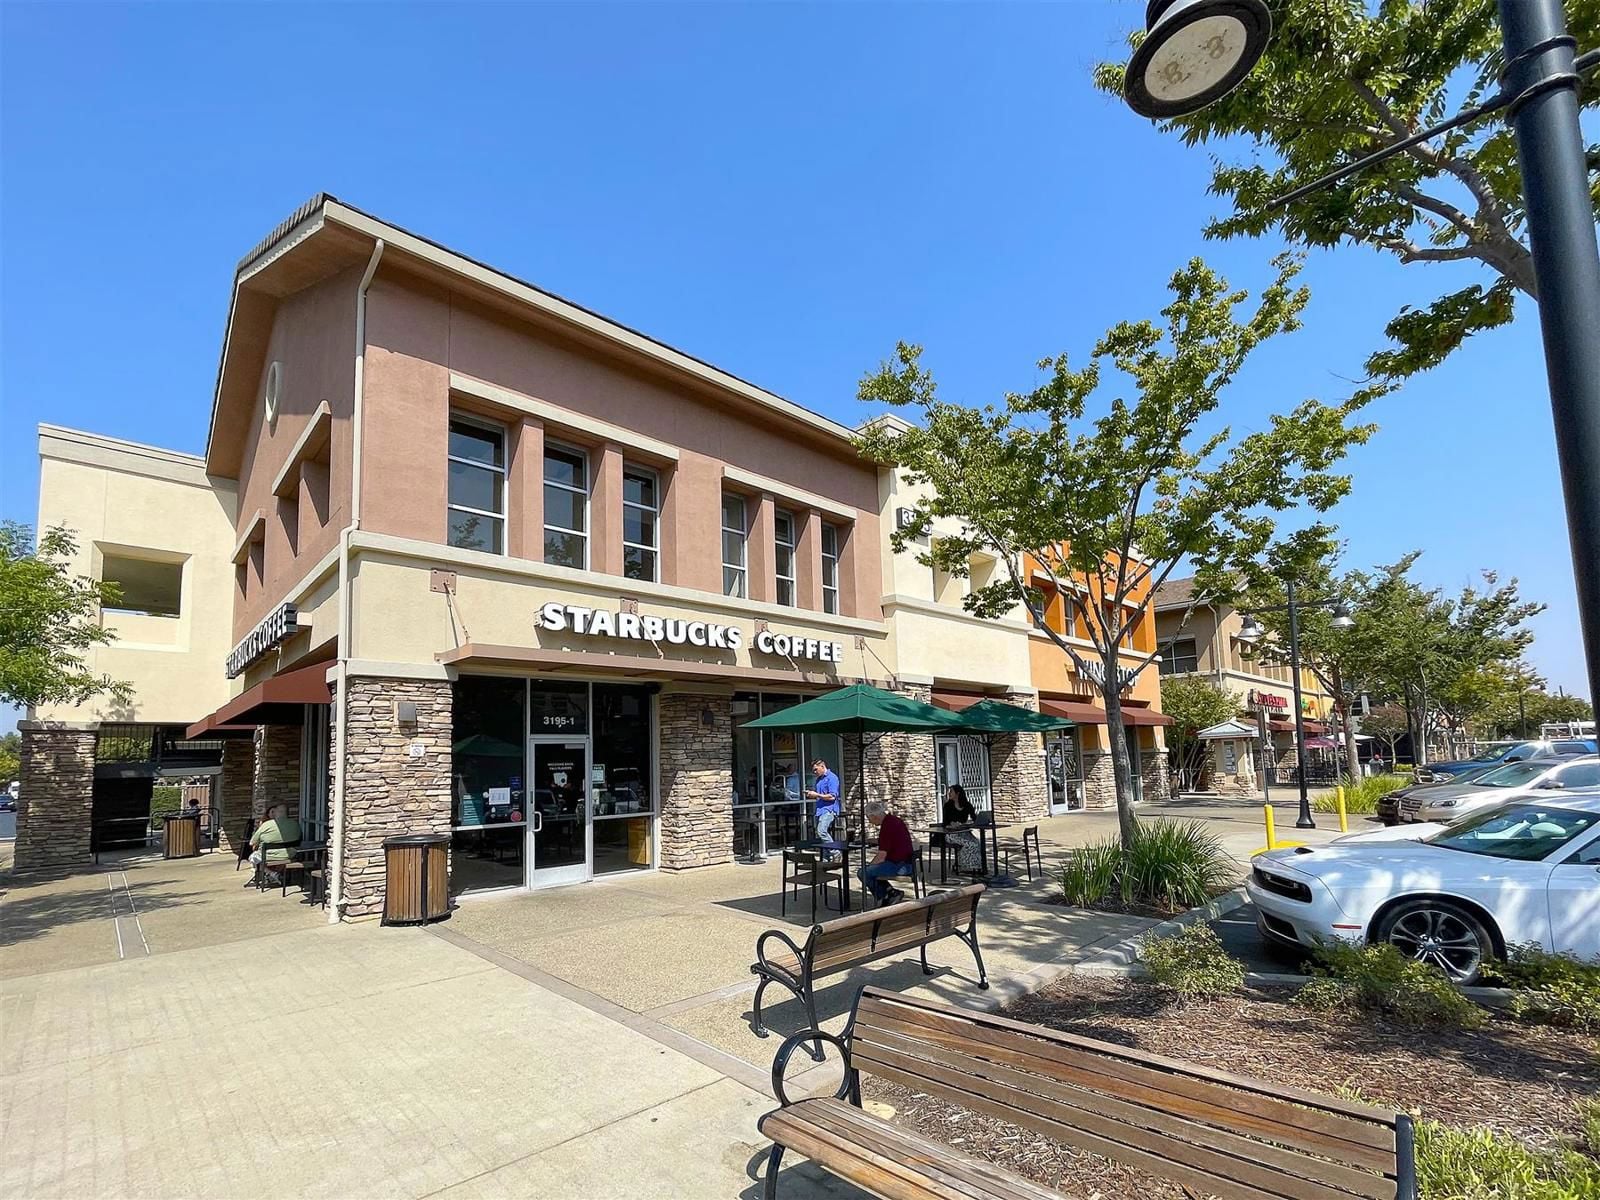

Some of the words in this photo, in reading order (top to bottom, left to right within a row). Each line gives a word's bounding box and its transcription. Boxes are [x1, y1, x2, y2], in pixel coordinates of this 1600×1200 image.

[258, 603, 288, 653] COFFEE
[542, 602, 743, 650] STARBUCKS
[756, 630, 843, 663] COFFEE
[543, 716, 575, 725] 3195-1
